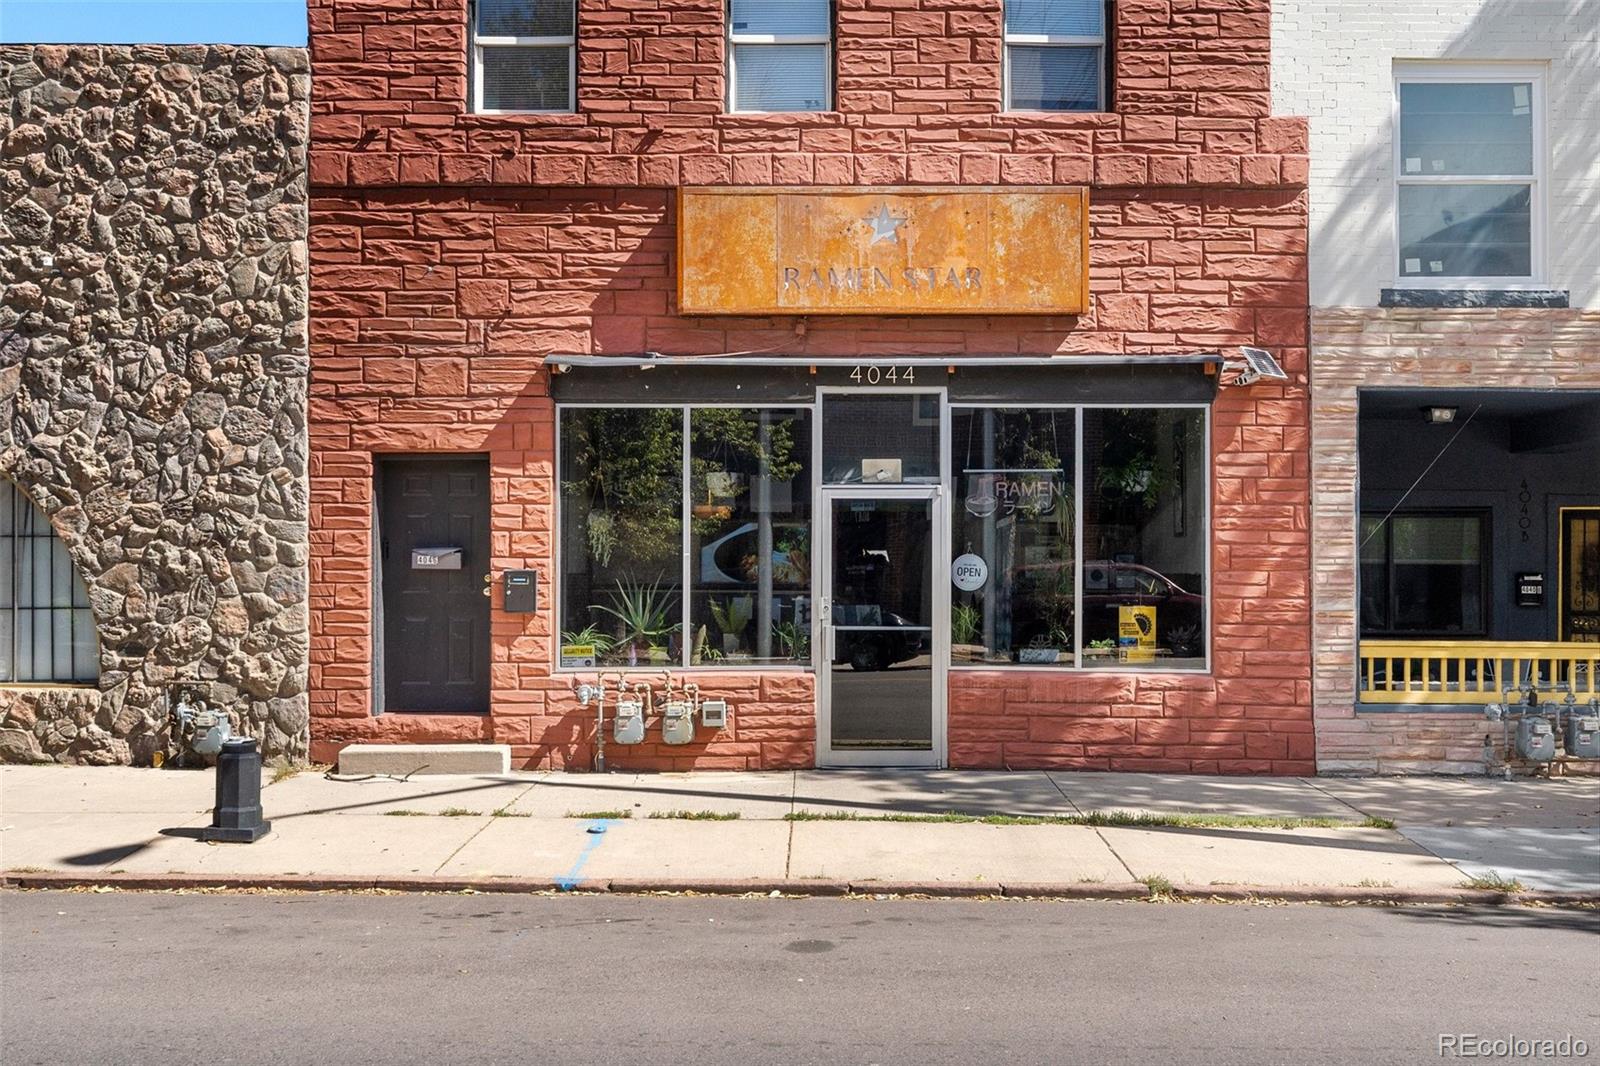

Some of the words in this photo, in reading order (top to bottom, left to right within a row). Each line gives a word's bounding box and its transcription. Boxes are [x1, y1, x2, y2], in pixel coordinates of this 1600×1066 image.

[784, 267, 893, 289] RAMEN
[903, 267, 982, 289] STAR
[849, 365, 915, 385] 4044
[995, 481, 1061, 497] RAMEN
[956, 567, 982, 577] OPEN
